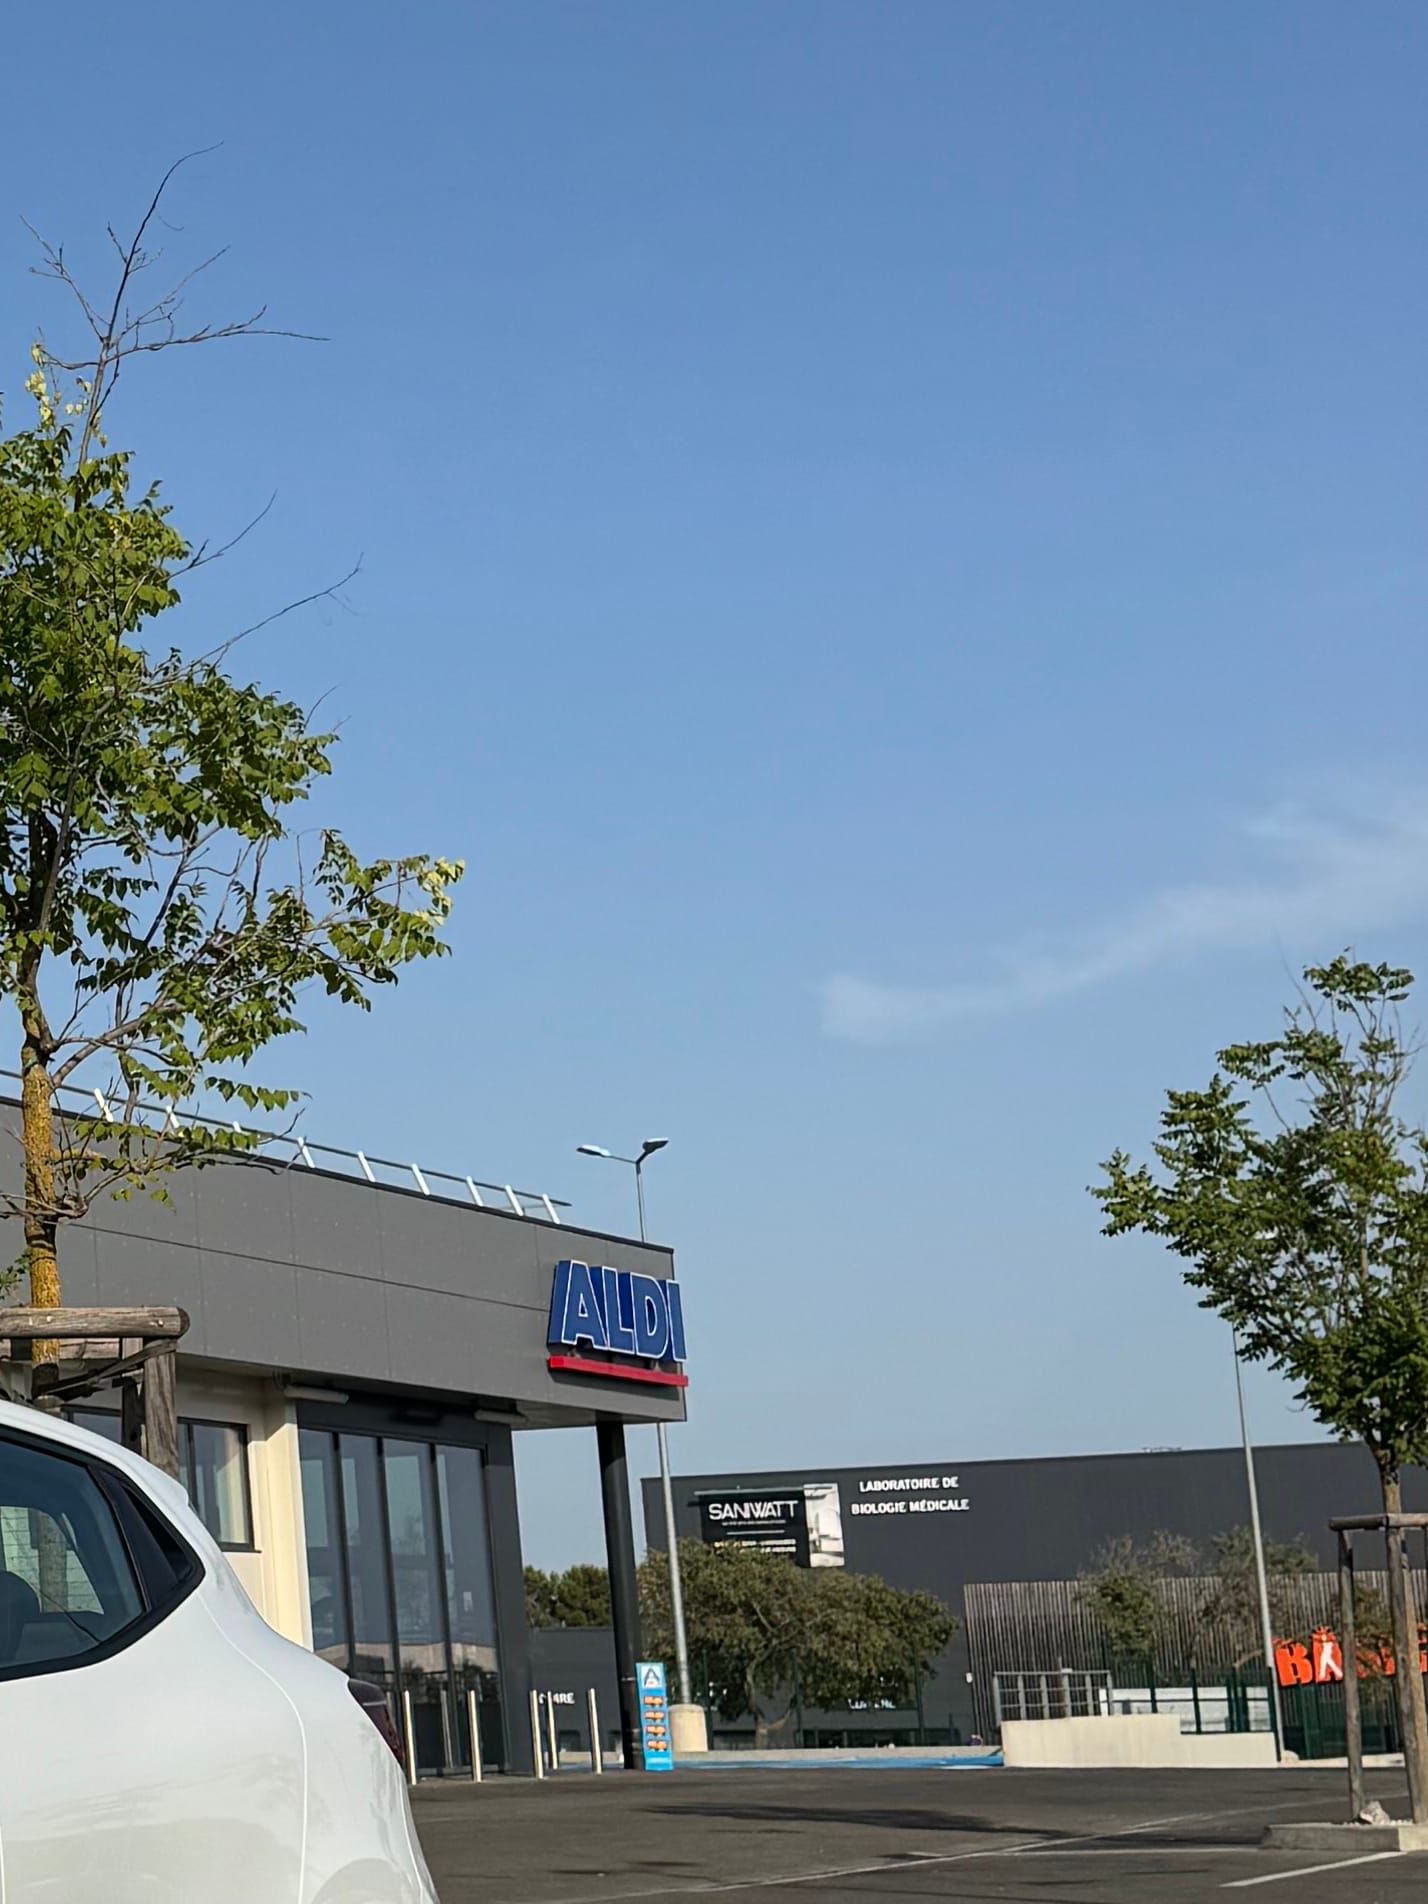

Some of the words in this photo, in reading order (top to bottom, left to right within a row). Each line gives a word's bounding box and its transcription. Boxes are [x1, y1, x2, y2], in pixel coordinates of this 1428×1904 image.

[559, 1259, 688, 1363] ALDI
[859, 1477, 940, 1492] LABORATOIRE
[942, 1476, 959, 1488] DE
[708, 1500, 799, 1520] SANIWATT
[851, 1501, 907, 1514] BIOLOGIE
[909, 1499, 970, 1512] MÉDICALE
